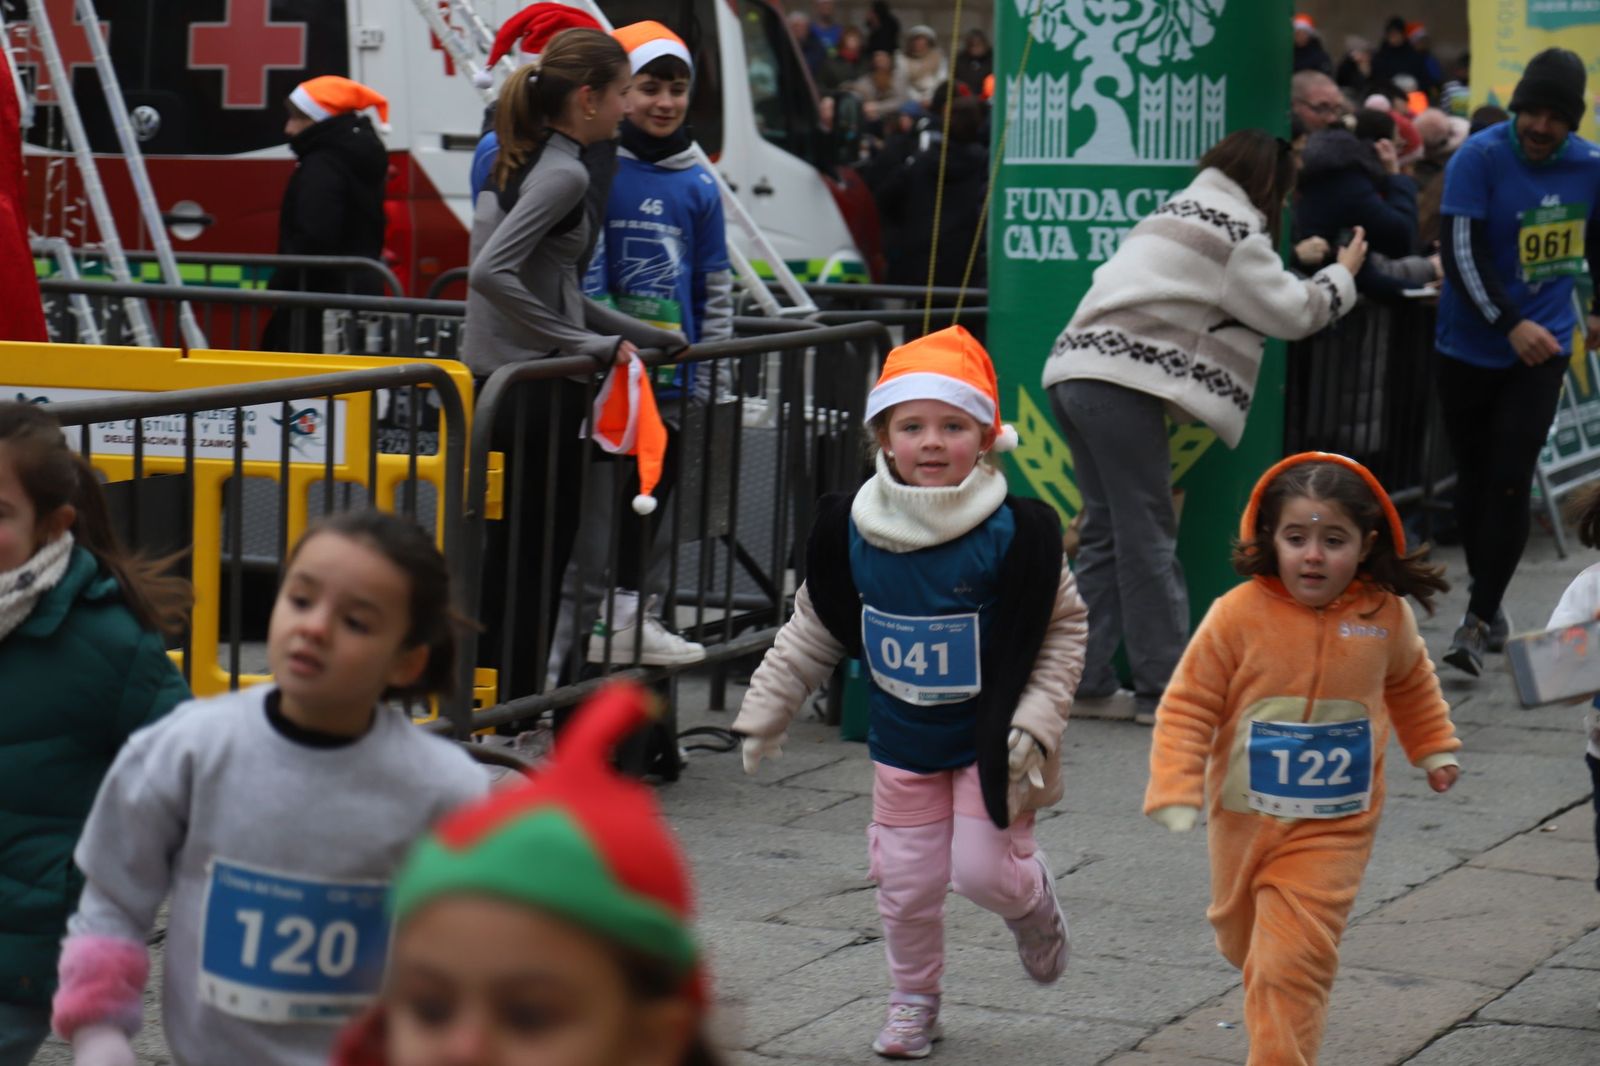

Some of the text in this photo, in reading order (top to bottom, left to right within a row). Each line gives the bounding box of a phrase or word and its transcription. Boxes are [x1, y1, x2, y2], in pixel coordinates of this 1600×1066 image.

[639, 197, 664, 216] 46
[1003, 225, 1078, 262] CAJA
[1525, 228, 1572, 262] 961
[201, 422, 210, 434] Y
[881, 637, 949, 675] 041
[1271, 747, 1352, 786] 122
[235, 908, 358, 978] 120
